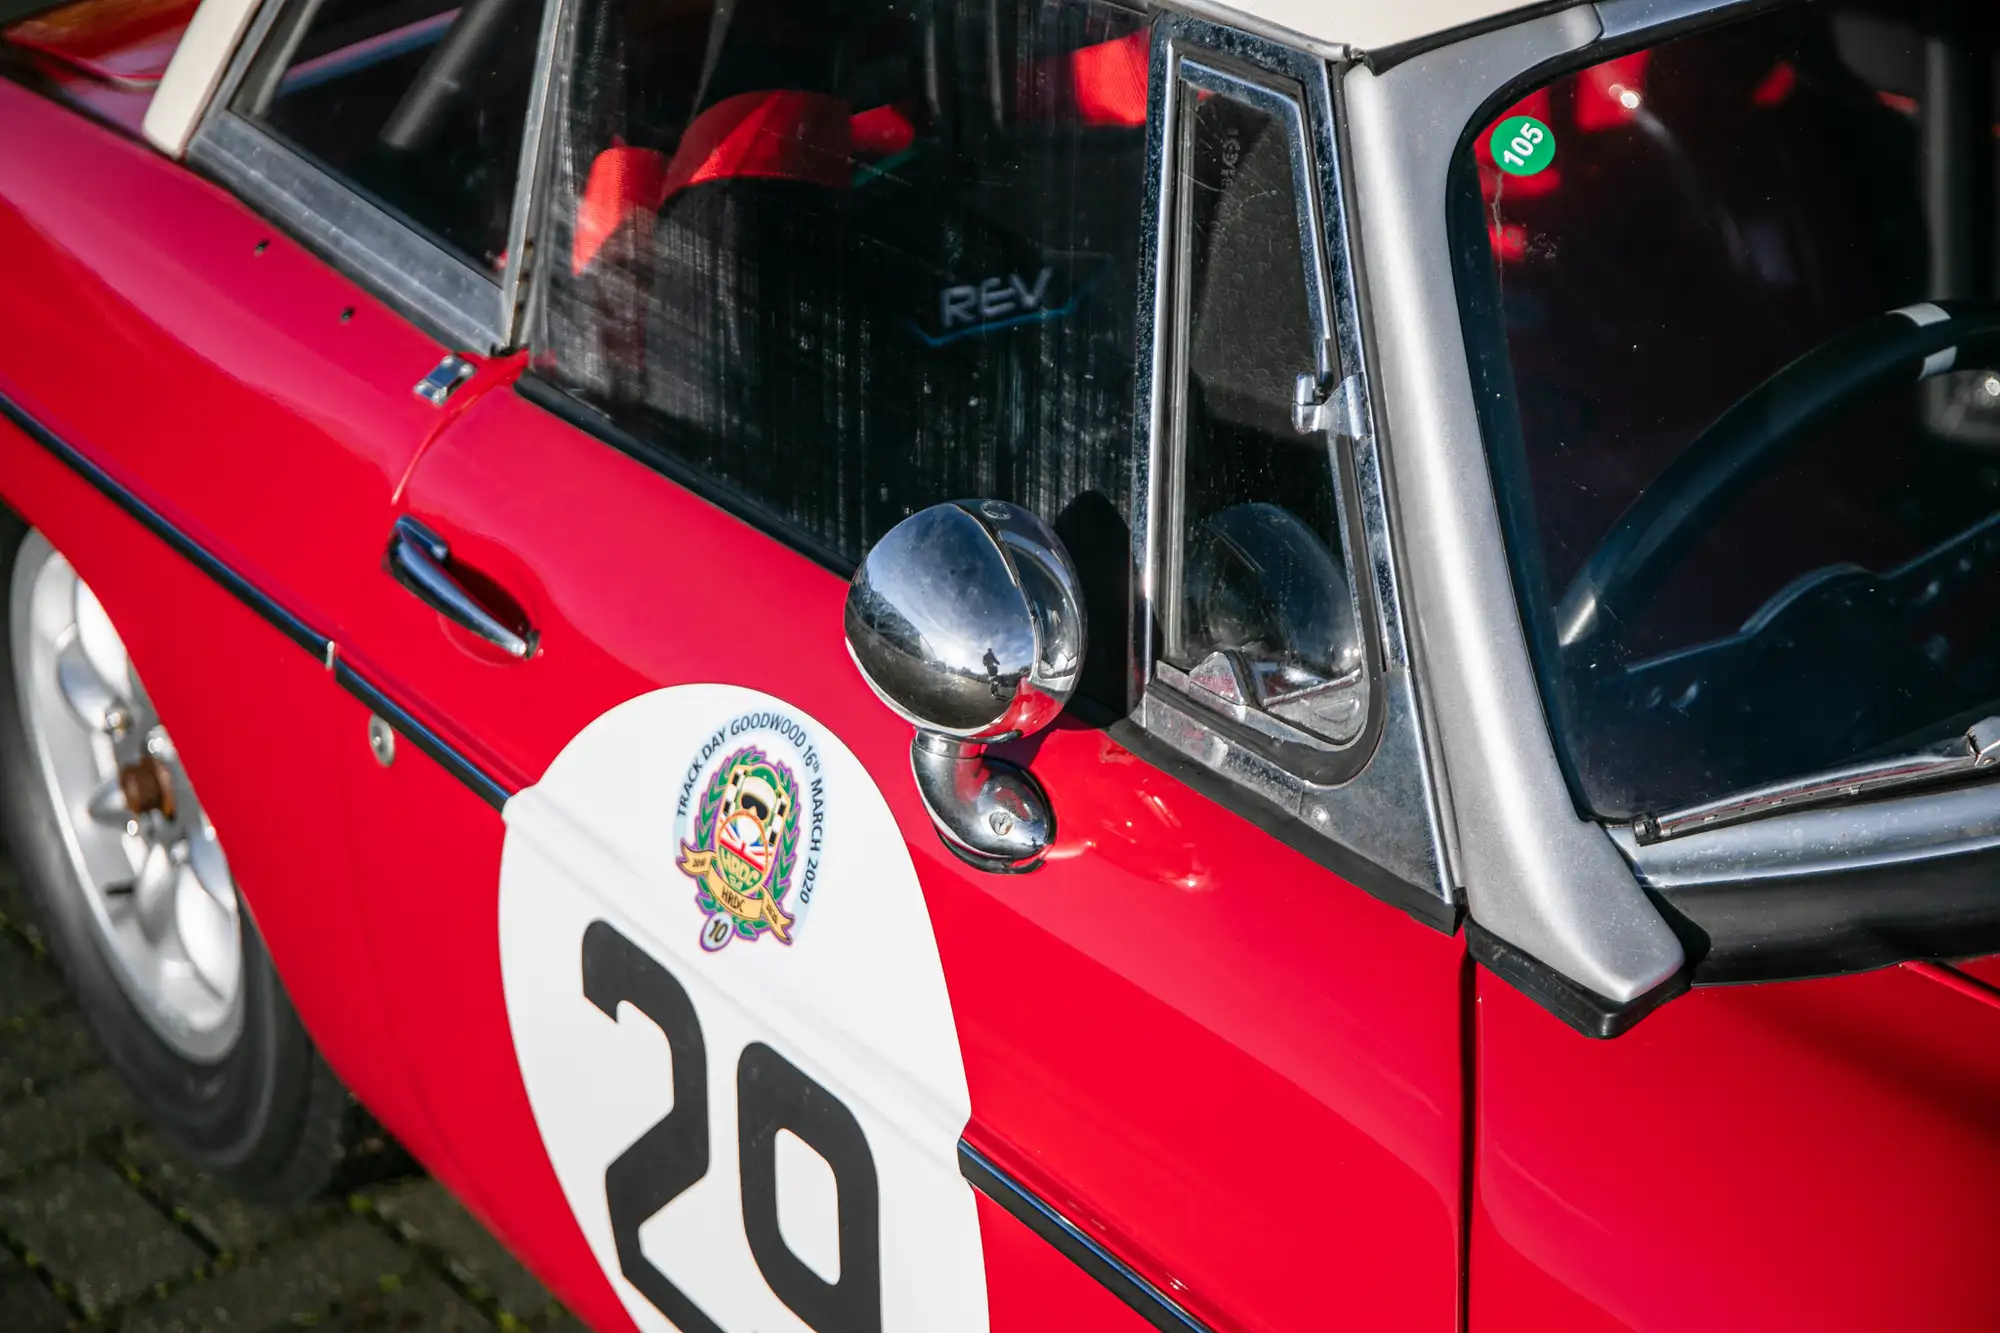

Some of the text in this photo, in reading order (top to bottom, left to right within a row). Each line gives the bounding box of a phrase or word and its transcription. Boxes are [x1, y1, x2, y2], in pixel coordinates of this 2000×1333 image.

[1503, 122, 1544, 167] 105
[941, 266, 1054, 327] REV
[677, 712, 824, 905] TRACK DAY GOODWOOD 16th MARCH 2020
[721, 885, 746, 913] HRDC
[708, 918, 729, 943] 10
